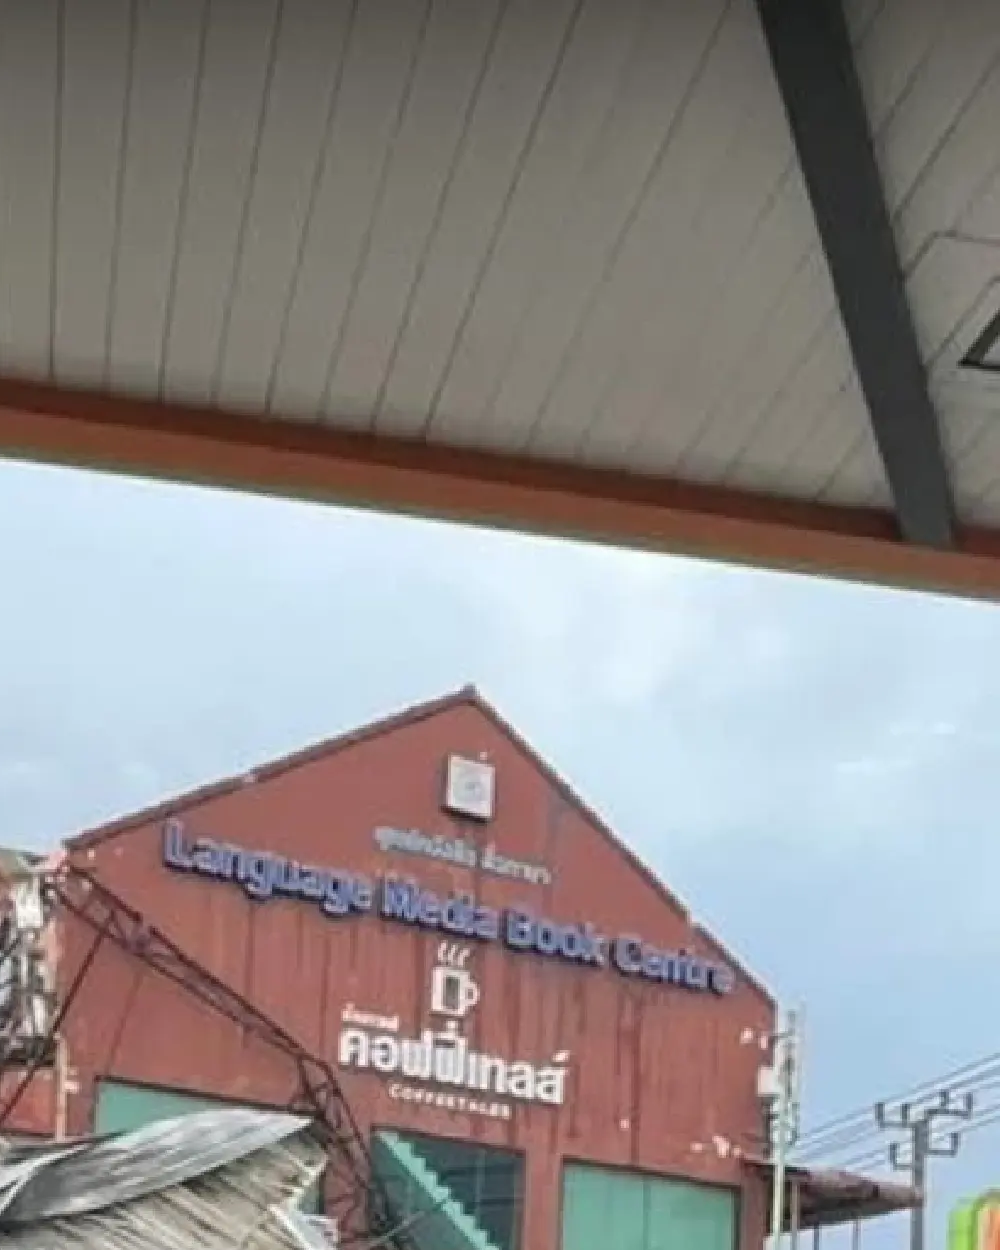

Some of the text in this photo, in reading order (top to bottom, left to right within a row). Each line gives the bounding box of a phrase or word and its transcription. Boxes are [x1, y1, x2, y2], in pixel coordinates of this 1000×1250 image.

[163, 817, 372, 915] Language
[381, 871, 499, 939] Media
[504, 907, 605, 967] Book
[613, 932, 736, 995] Centre
